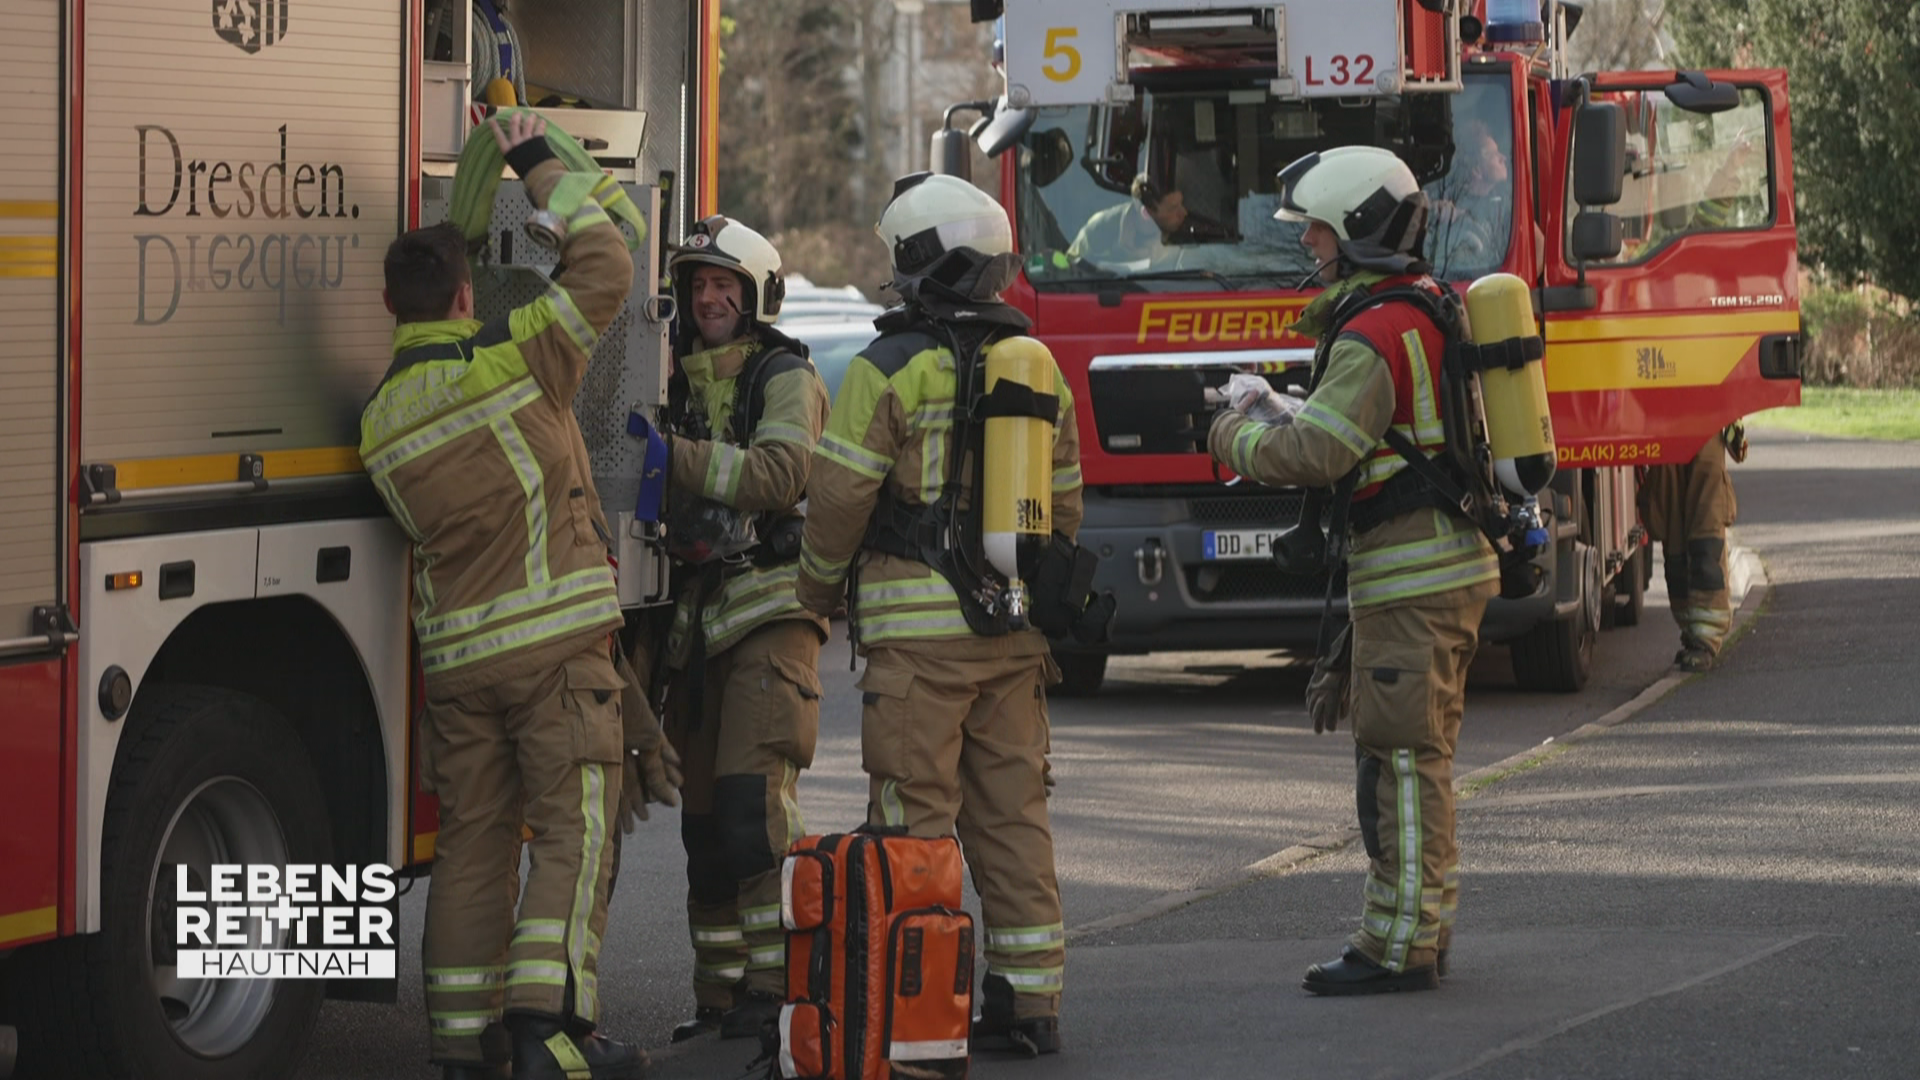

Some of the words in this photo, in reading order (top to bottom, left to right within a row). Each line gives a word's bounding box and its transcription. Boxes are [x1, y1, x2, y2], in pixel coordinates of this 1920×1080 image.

[1041, 26, 1082, 83] 5
[1305, 54, 1374, 86] L32
[132, 123, 360, 220] Dresden.
[695, 235, 704, 247] 5
[1710, 295, 1737, 307] TGM
[1557, 444, 1615, 463] DLA(K)
[1618, 443, 1662, 460] 23-12
[1217, 534, 1241, 555] DD
